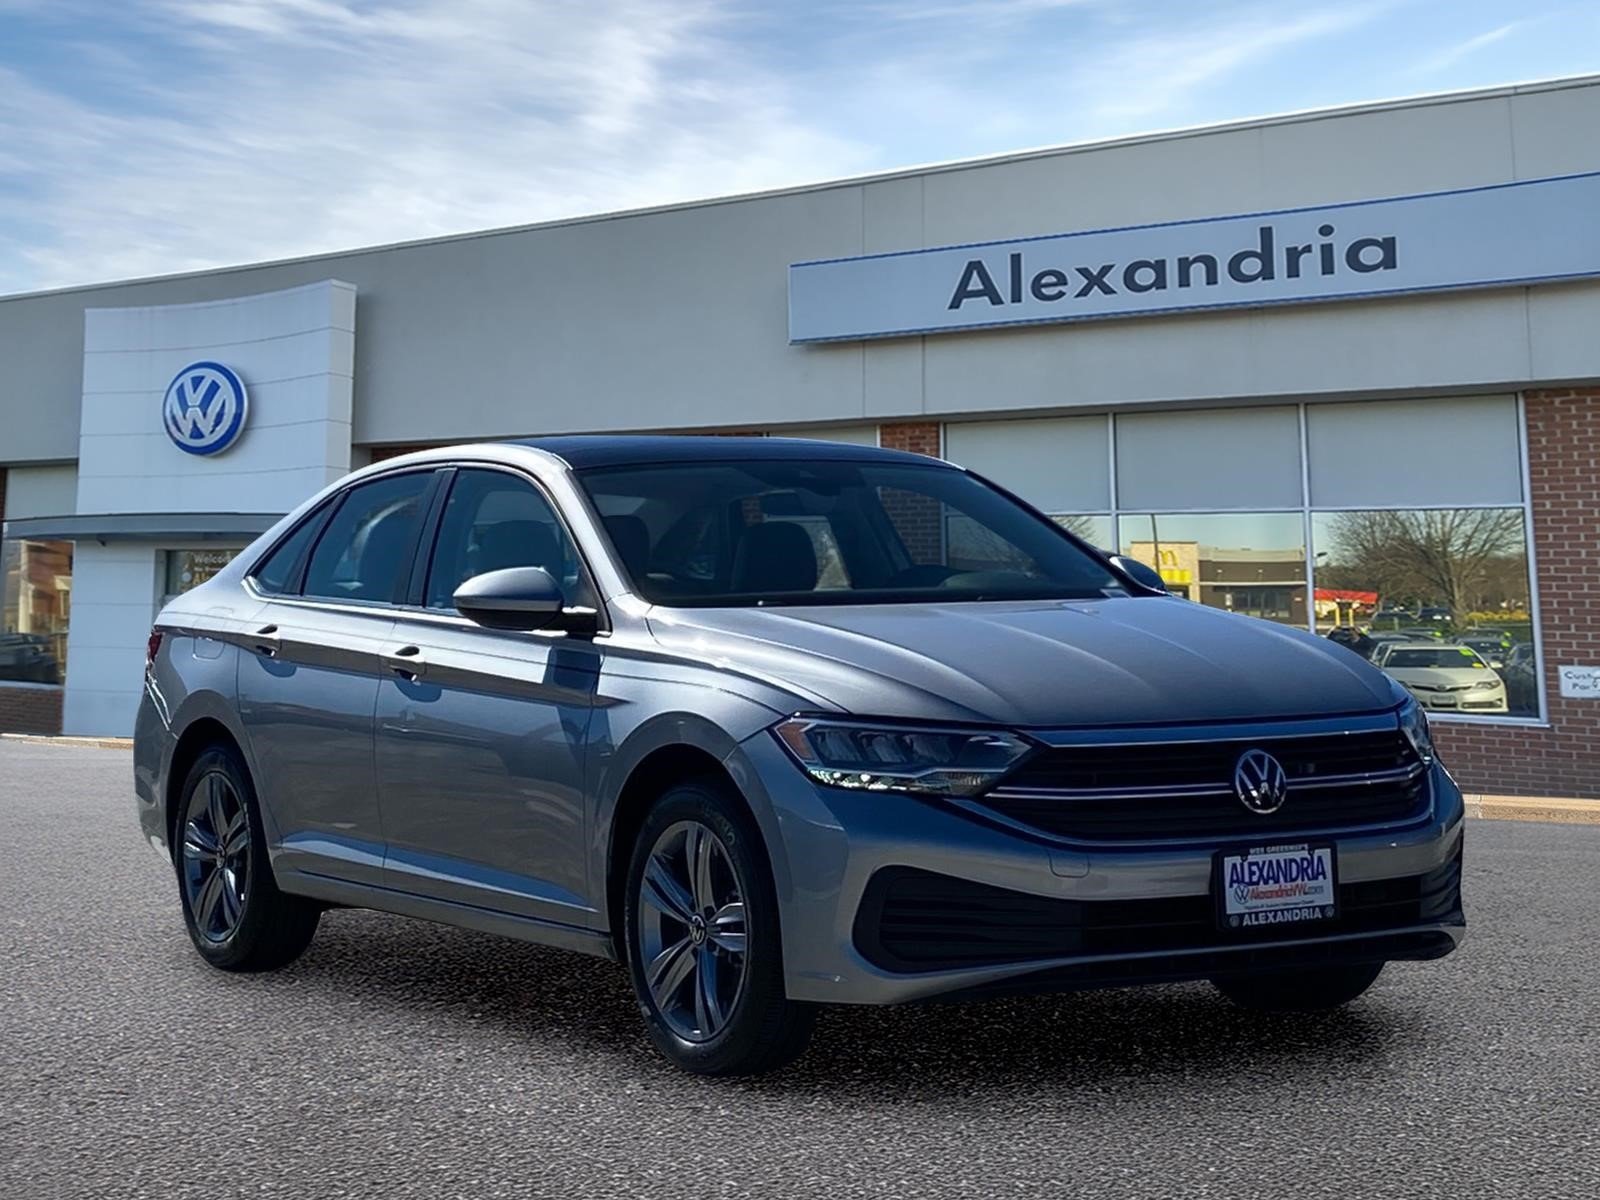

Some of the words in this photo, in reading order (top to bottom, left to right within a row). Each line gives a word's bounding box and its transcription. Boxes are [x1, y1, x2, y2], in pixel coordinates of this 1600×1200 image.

[948, 226, 1397, 310] Alexandria
[1229, 855, 1327, 888] ALEXANDRIA
[1243, 907, 1322, 927] ALEXANDRIA
